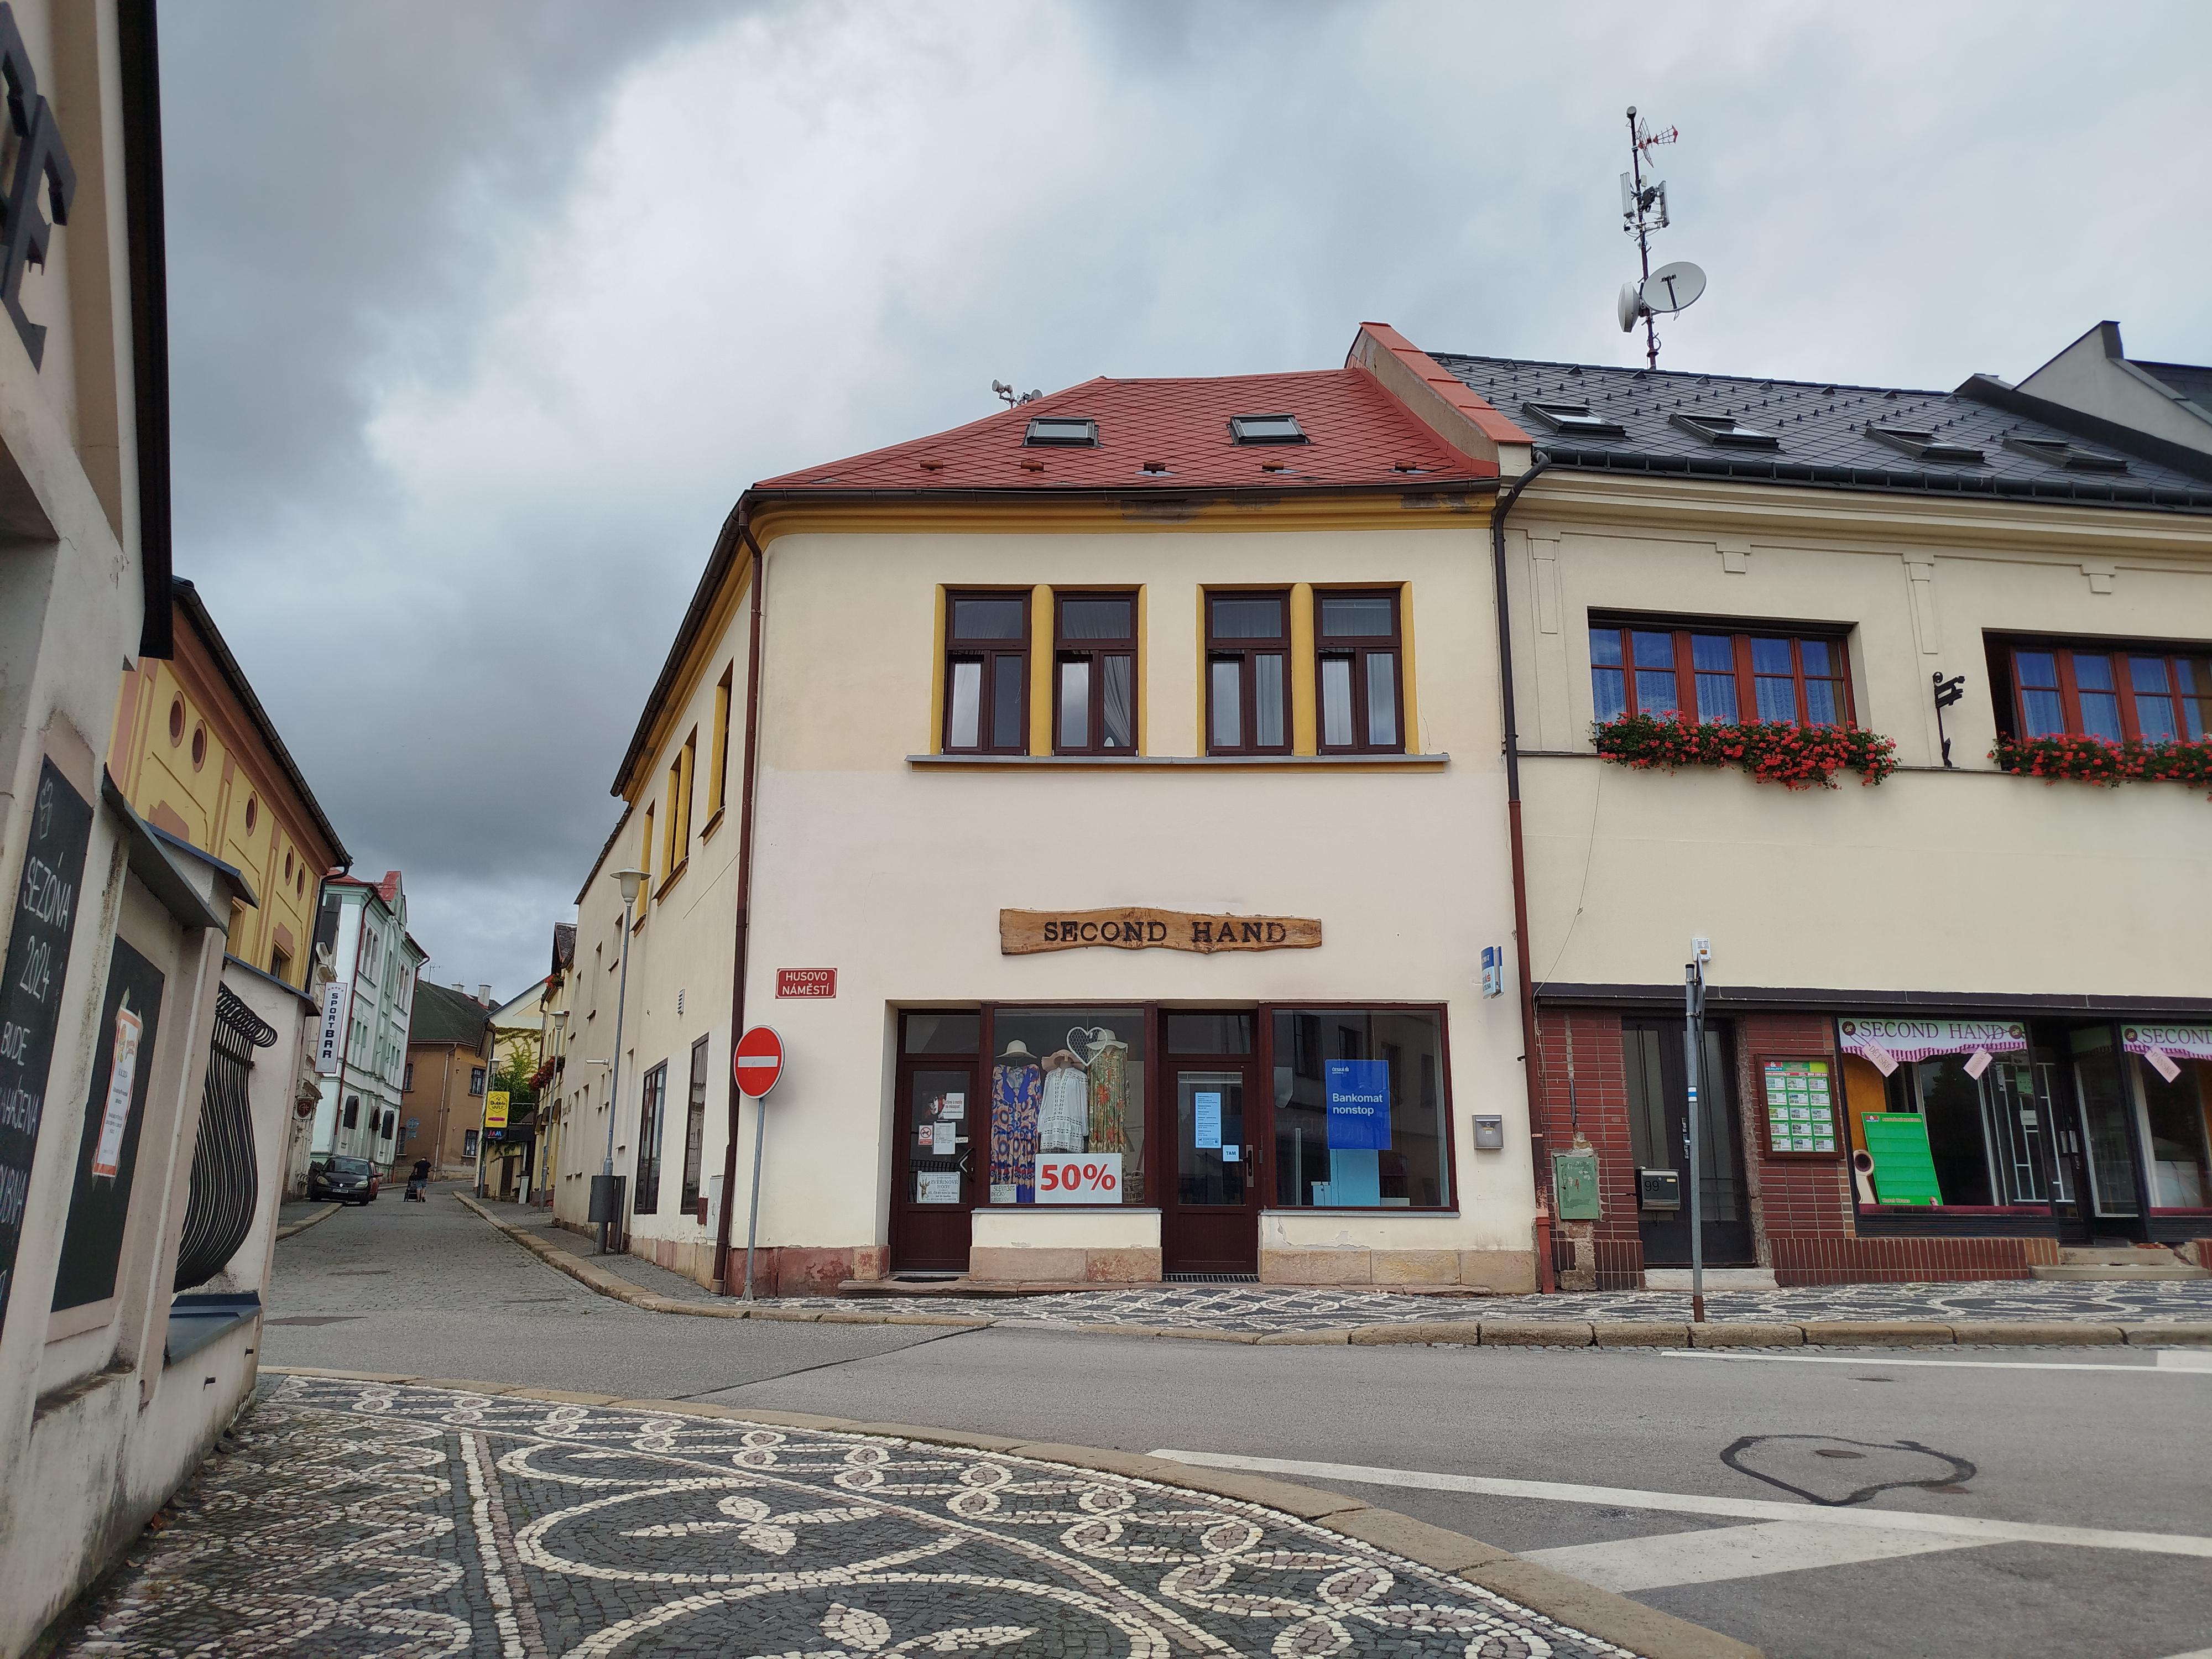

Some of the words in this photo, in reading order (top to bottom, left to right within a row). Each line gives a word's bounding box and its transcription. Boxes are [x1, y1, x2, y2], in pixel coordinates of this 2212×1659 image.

[1044, 921, 1167, 942] SECOND
[1192, 921, 1286, 943] HAND
[20, 935, 51, 1003] 2024
[785, 972, 828, 982] HUSOVO
[782, 983, 830, 995] NÁMĚSTÍ
[322, 993, 338, 1058] SPORTBAR
[1860, 1021, 1939, 1038] SECOND
[1950, 1023, 2005, 1040] HAND
[1, 1021, 31, 1066] BUDE
[1332, 1093, 1383, 1103] Bankomat
[1333, 1105, 1375, 1117] nonstop
[1040, 1163, 1117, 1191] 50%
[1645, 1180, 1660, 1192] 99
